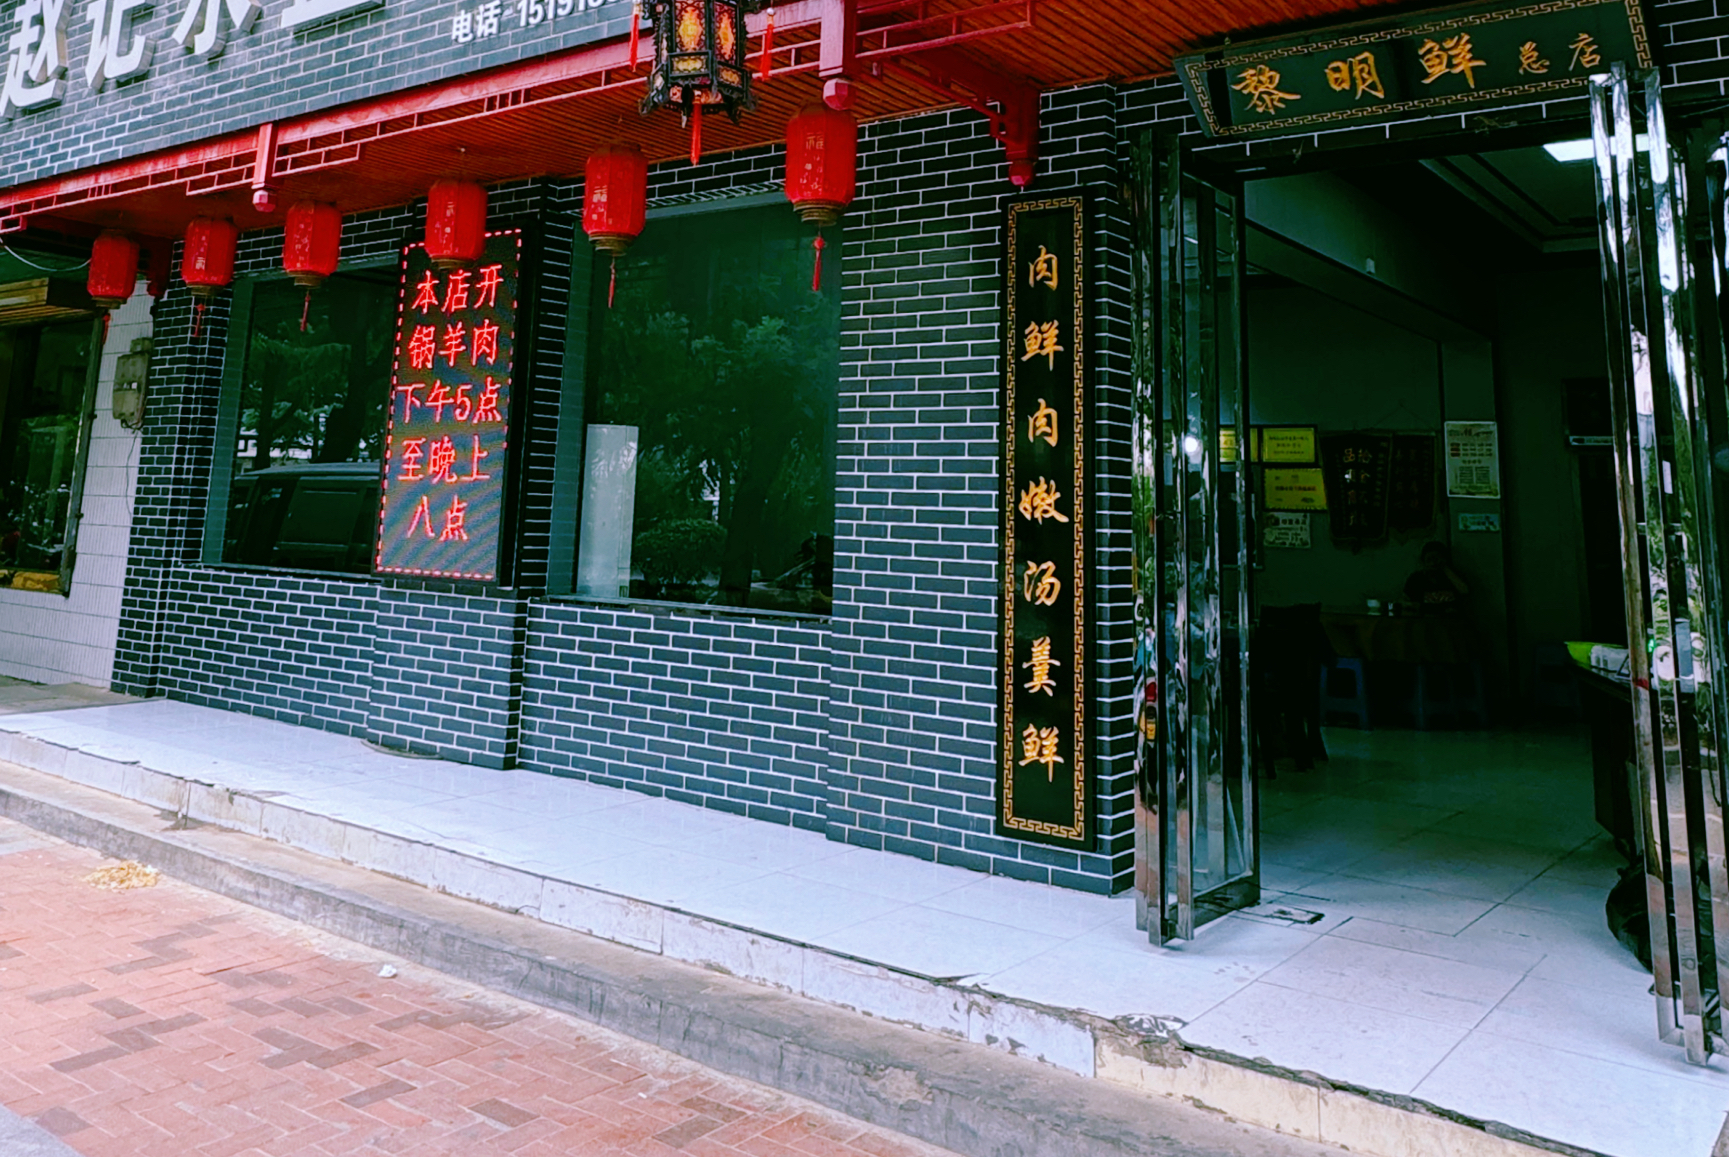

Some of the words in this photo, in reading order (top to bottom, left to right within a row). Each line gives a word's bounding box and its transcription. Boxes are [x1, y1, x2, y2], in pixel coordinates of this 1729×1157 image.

[452, 0, 501, 43] 电话
[412, 264, 504, 314] 本店开
[408, 320, 499, 370] 锅羊肉
[397, 378, 502, 423] 下午5点
[398, 434, 490, 484] 至晚上
[405, 494, 468, 541] 八点
[1019, 245, 1068, 783] 肉鲜肉嫩汤羹鲜
